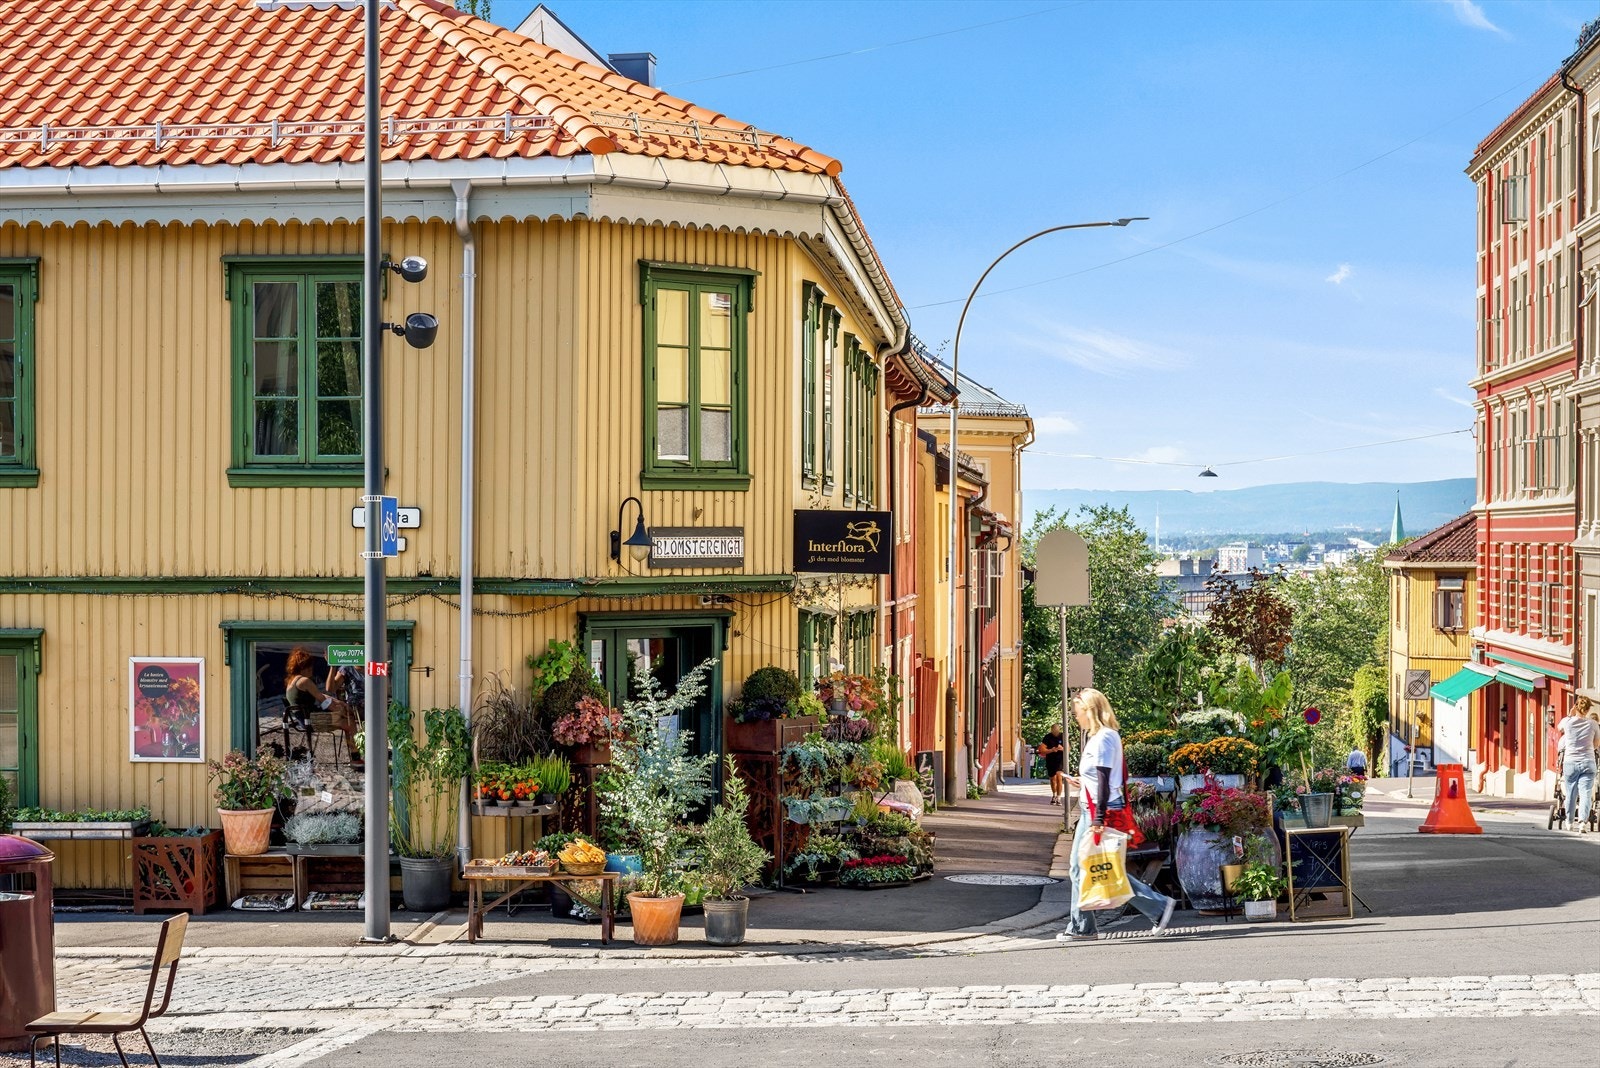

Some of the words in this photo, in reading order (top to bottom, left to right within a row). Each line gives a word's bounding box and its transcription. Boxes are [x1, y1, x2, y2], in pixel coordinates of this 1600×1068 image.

[656, 540, 741, 555] BLOMSTERENGA
[808, 540, 865, 553] Interflora
[332, 650, 347, 658] Vipps
